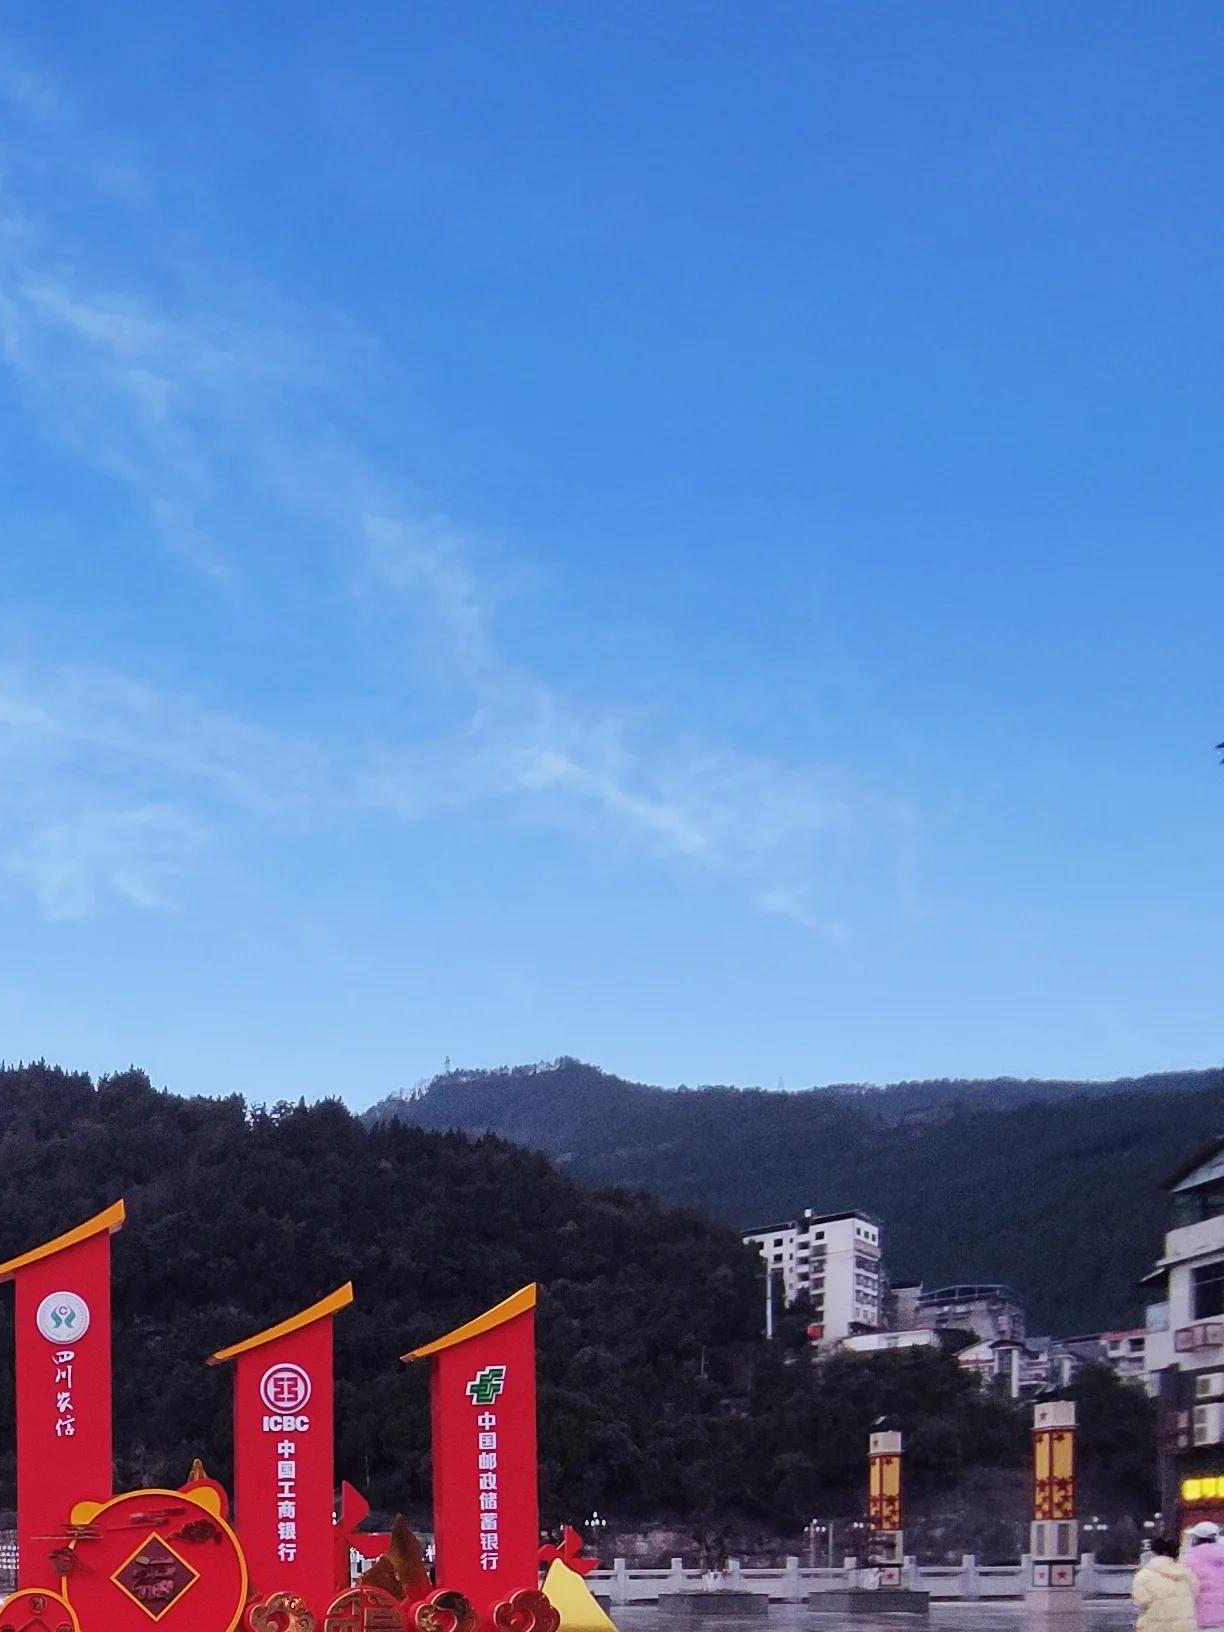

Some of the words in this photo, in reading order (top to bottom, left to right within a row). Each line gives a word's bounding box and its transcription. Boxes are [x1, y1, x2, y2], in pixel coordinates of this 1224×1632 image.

[52, 1350, 76, 1437] 四川农信
[262, 1415, 310, 1432] ICBC
[277, 1439, 297, 1562] 中国工商银行
[477, 1411, 499, 1570] 中国邮政储蓄银行
